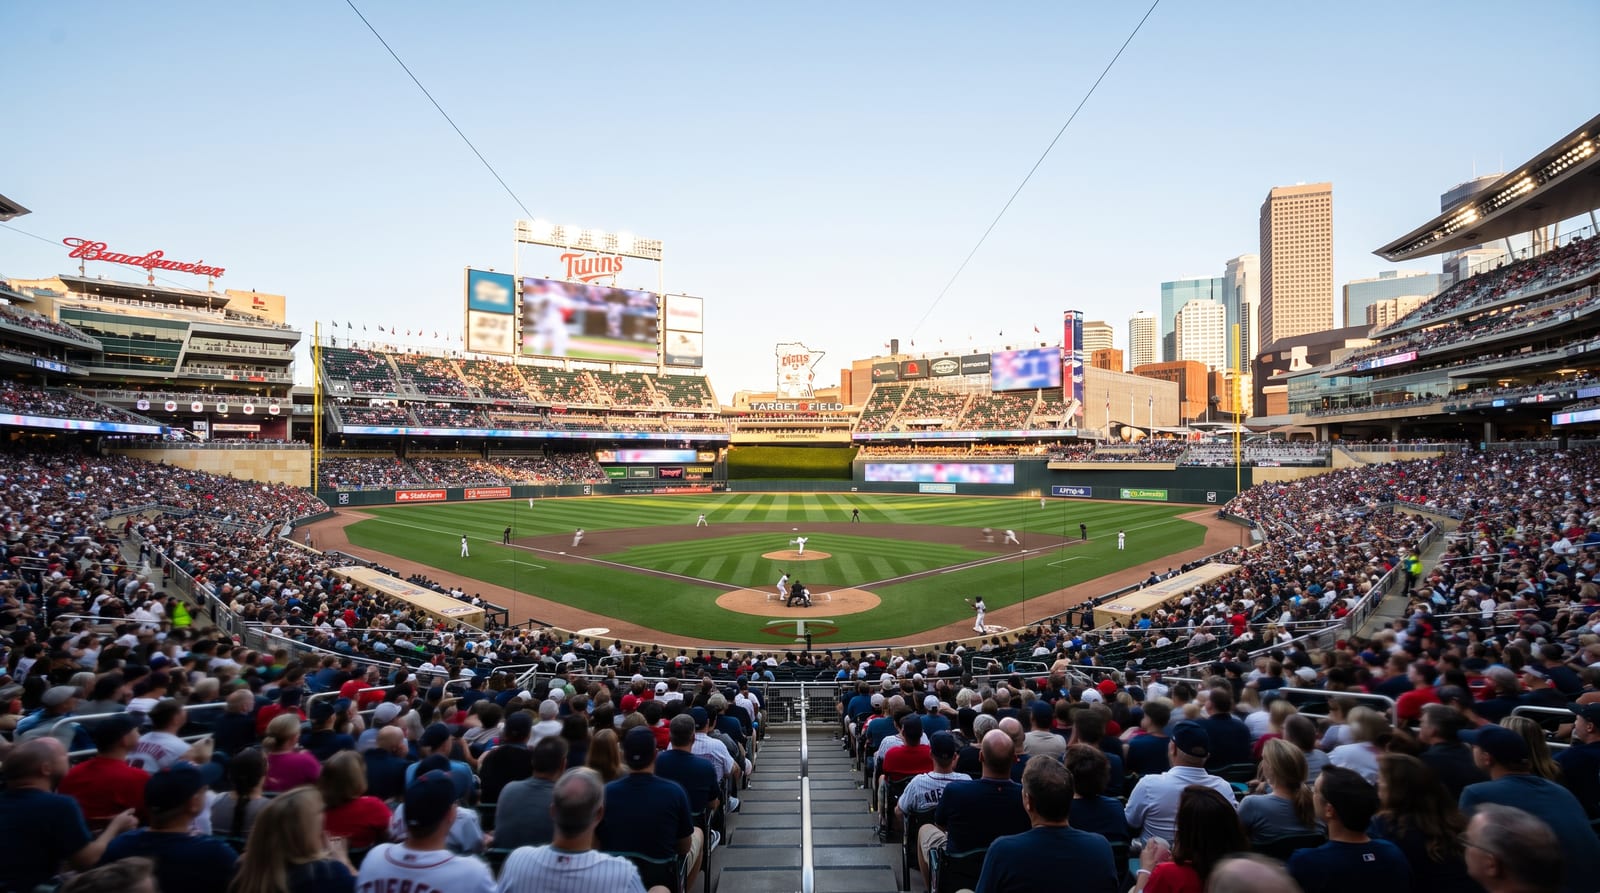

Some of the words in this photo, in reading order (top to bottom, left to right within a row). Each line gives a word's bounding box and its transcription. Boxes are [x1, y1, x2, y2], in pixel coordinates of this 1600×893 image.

[560, 252, 623, 279] Twins
[751, 402, 798, 412] TARGET
[808, 402, 844, 412] FIELD
